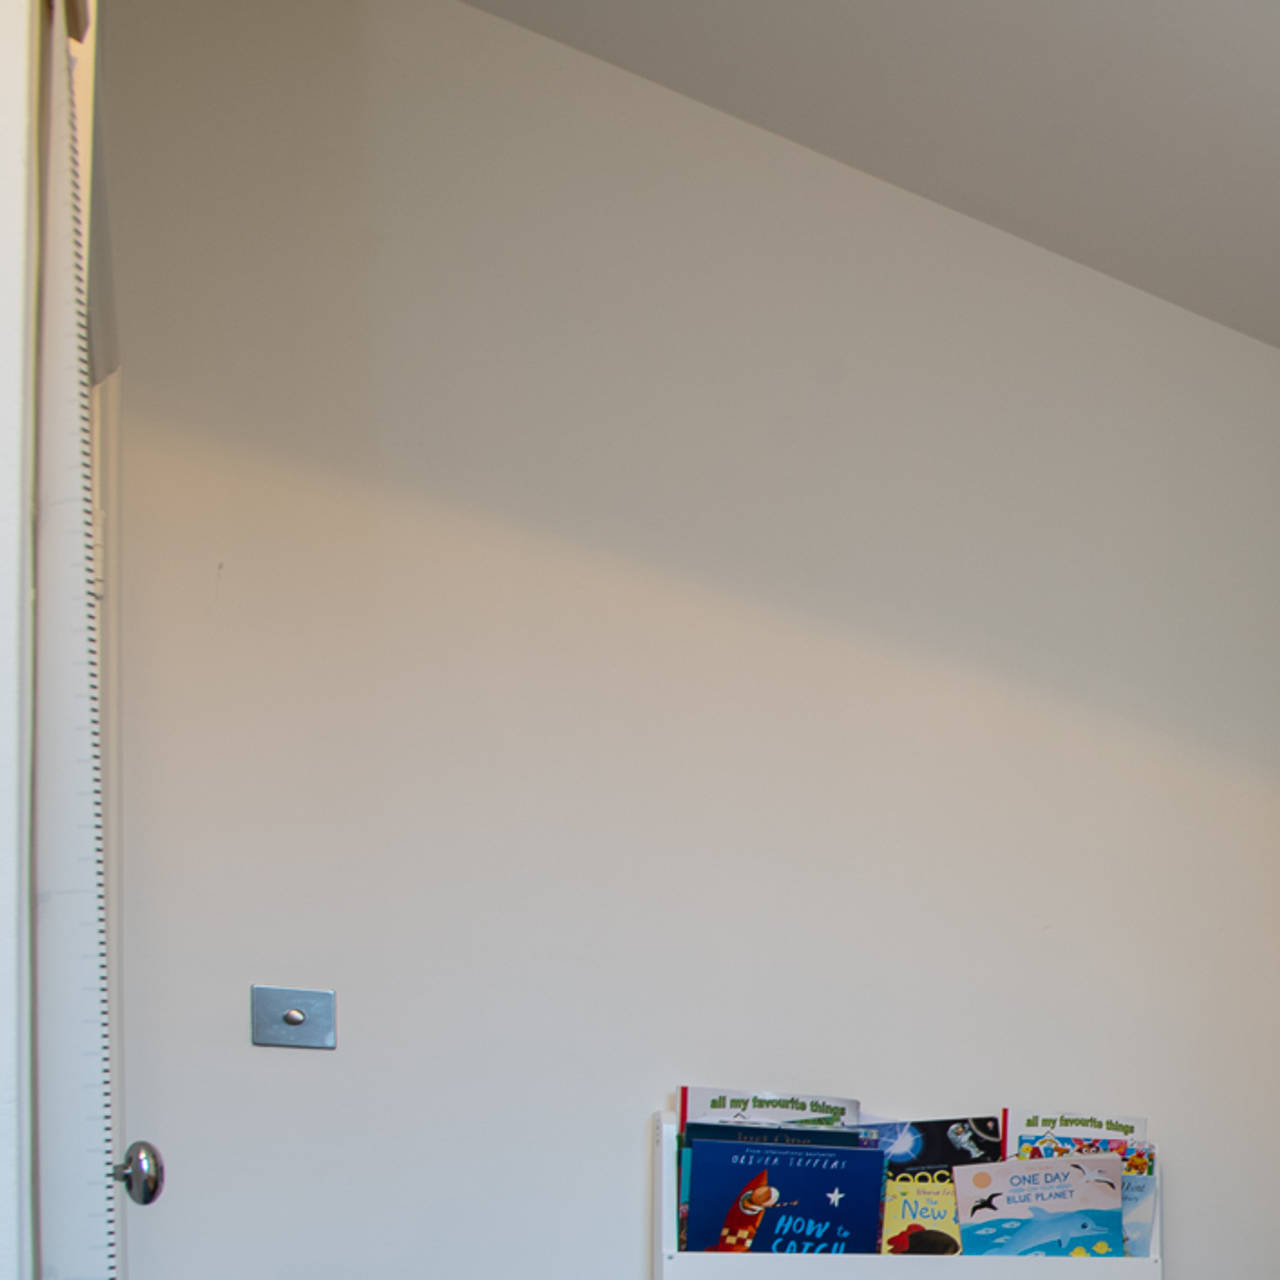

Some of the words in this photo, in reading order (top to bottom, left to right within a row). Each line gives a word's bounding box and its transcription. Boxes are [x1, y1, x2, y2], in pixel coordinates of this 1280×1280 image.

[709, 1095, 727, 1109] all
[729, 1096, 750, 1112] my
[752, 1095, 807, 1112] favourite
[810, 1100, 846, 1117] things
[1025, 1115, 1039, 1128] all
[1041, 1116, 1057, 1130] my
[1059, 1114, 1103, 1129] favourite
[1105, 1119, 1135, 1135] things
[1009, 1173, 1041, 1187] ONE
[1044, 1170, 1071, 1185] DAY
[1034, 1189, 1075, 1202] PLANET
[901, 1198, 948, 1221] New
[774, 1214, 831, 1239] HOW
